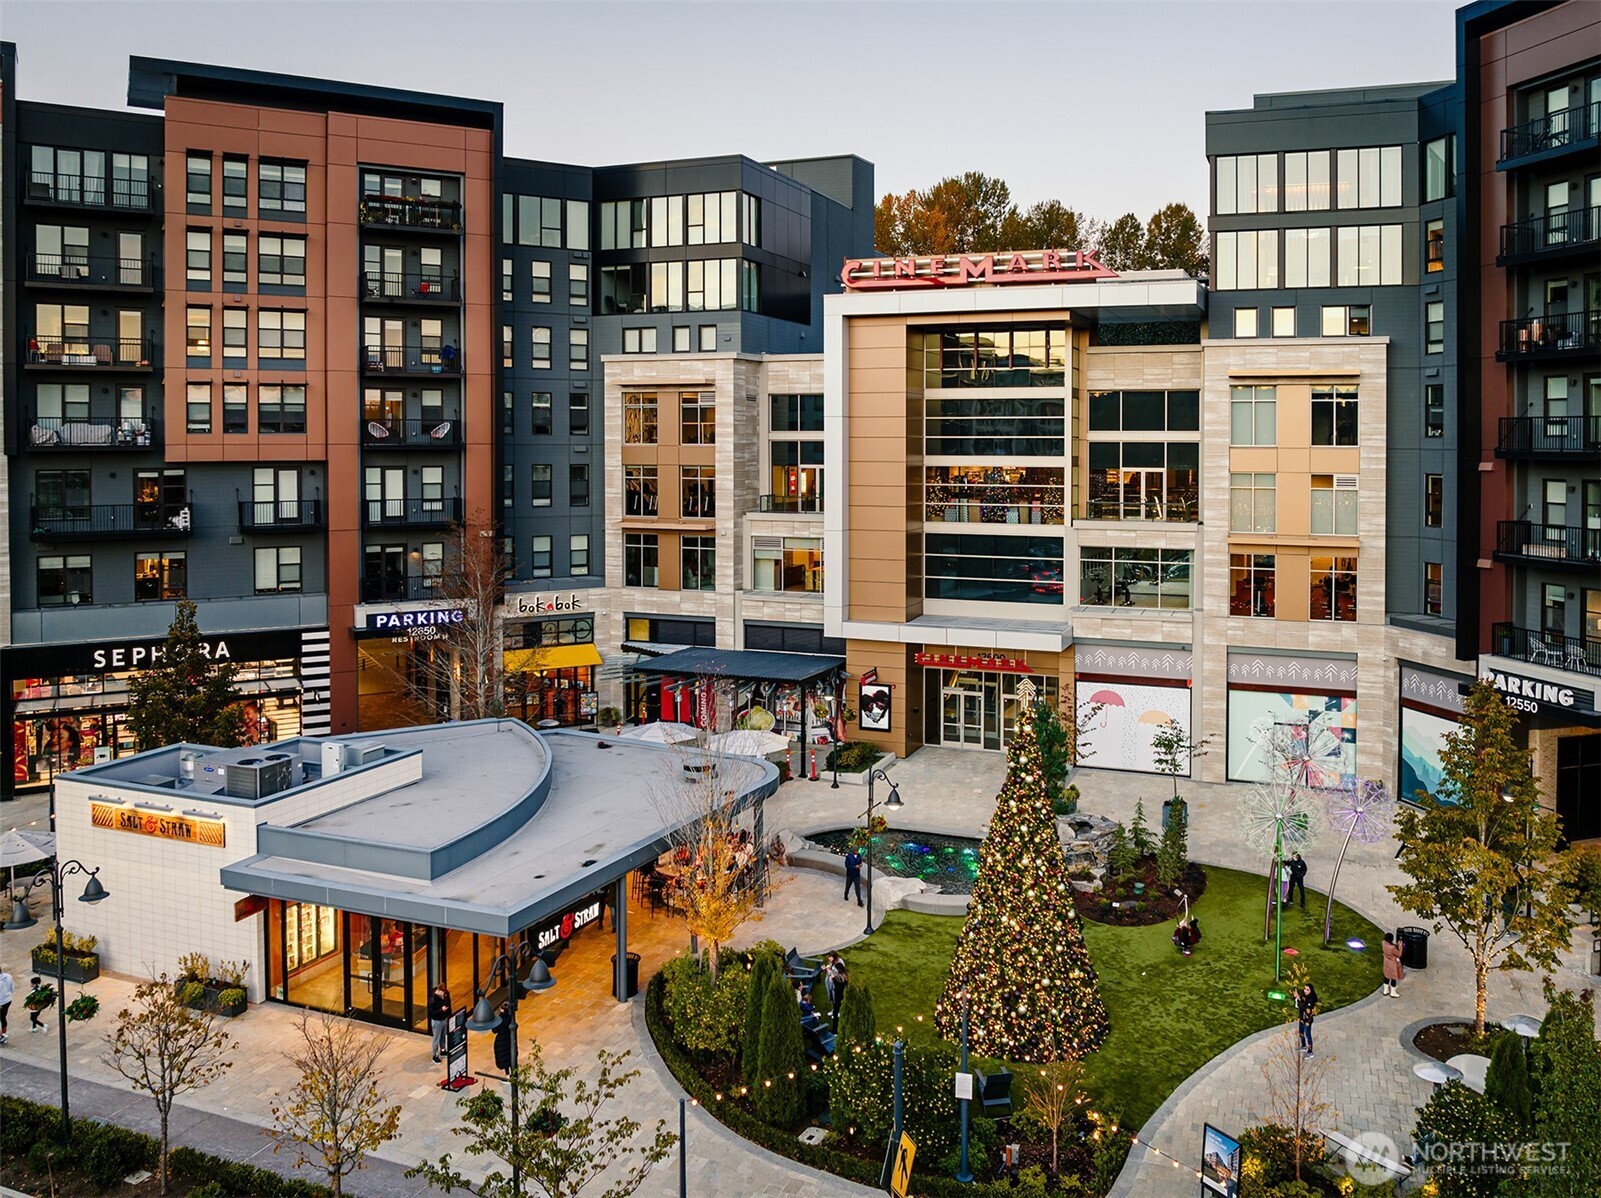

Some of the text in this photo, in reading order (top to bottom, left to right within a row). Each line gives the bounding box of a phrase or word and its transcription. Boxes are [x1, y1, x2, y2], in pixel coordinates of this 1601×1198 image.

[841, 249, 1120, 288] CINEMARK
[376, 610, 464, 628] PARKING
[1482, 671, 1574, 707] PARKING
[1505, 695, 1538, 714] 12550
[700, 692, 708, 727] COMING
[120, 811, 192, 838] SALT & STRAW
[538, 924, 561, 950] SALT
[574, 901, 600, 929] STRAW
